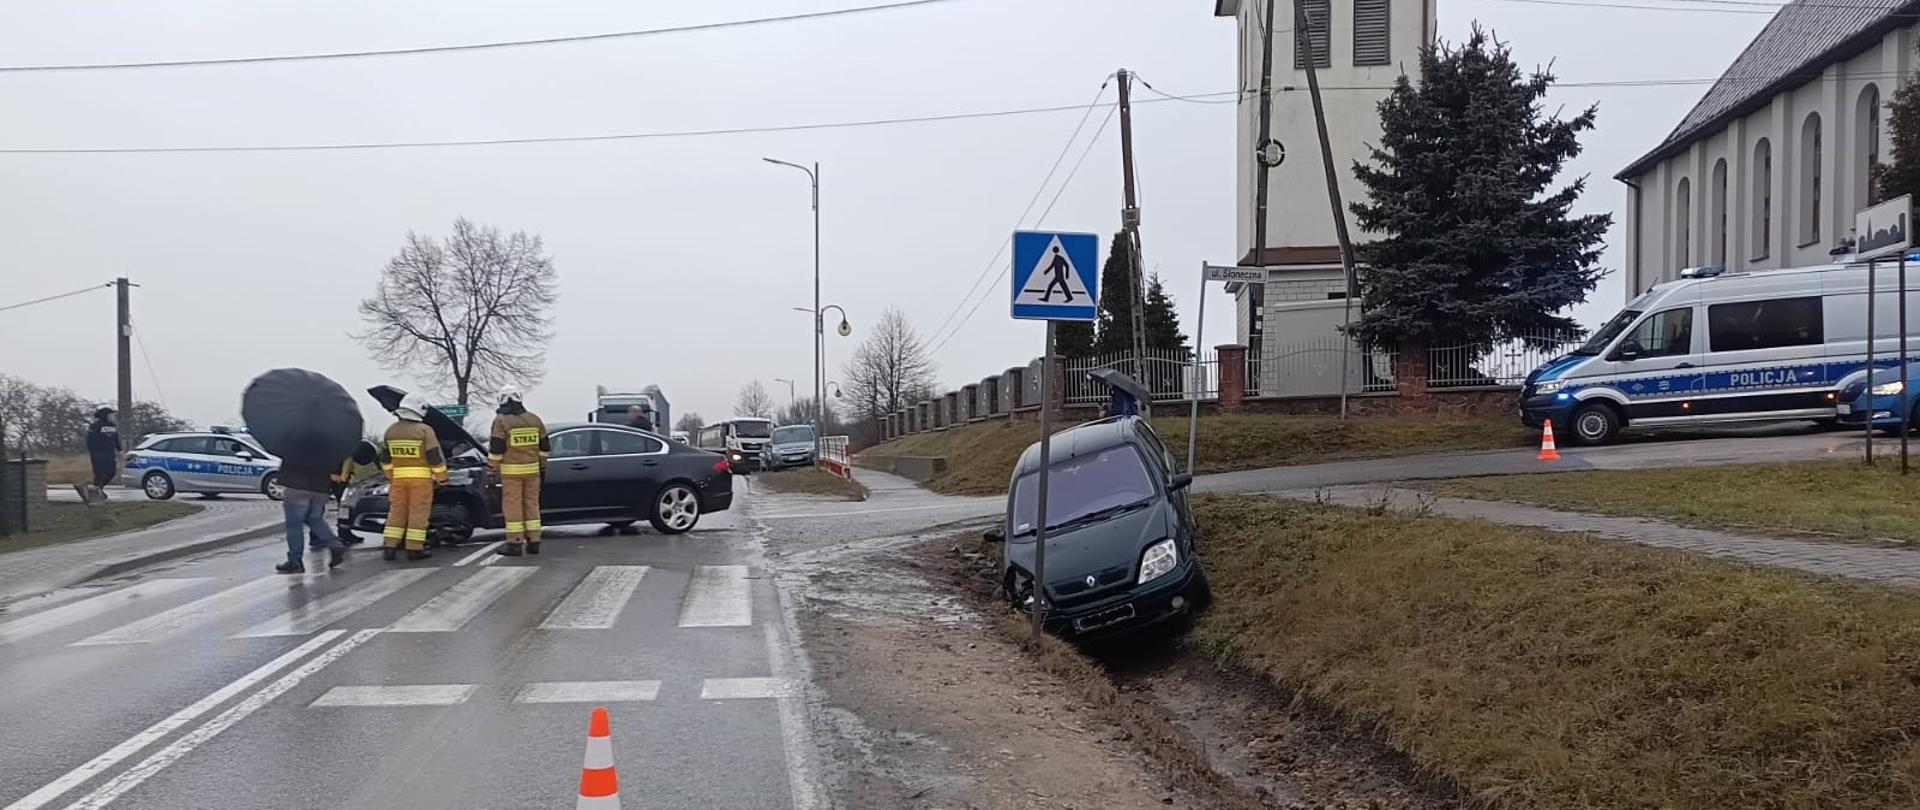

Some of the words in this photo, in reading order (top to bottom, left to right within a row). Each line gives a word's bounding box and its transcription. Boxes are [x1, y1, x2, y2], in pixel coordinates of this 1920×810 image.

[1211, 269, 1221, 278] ul.
[1730, 370, 1797, 386] POLICJA
[217, 464, 253, 475] POLICJA
